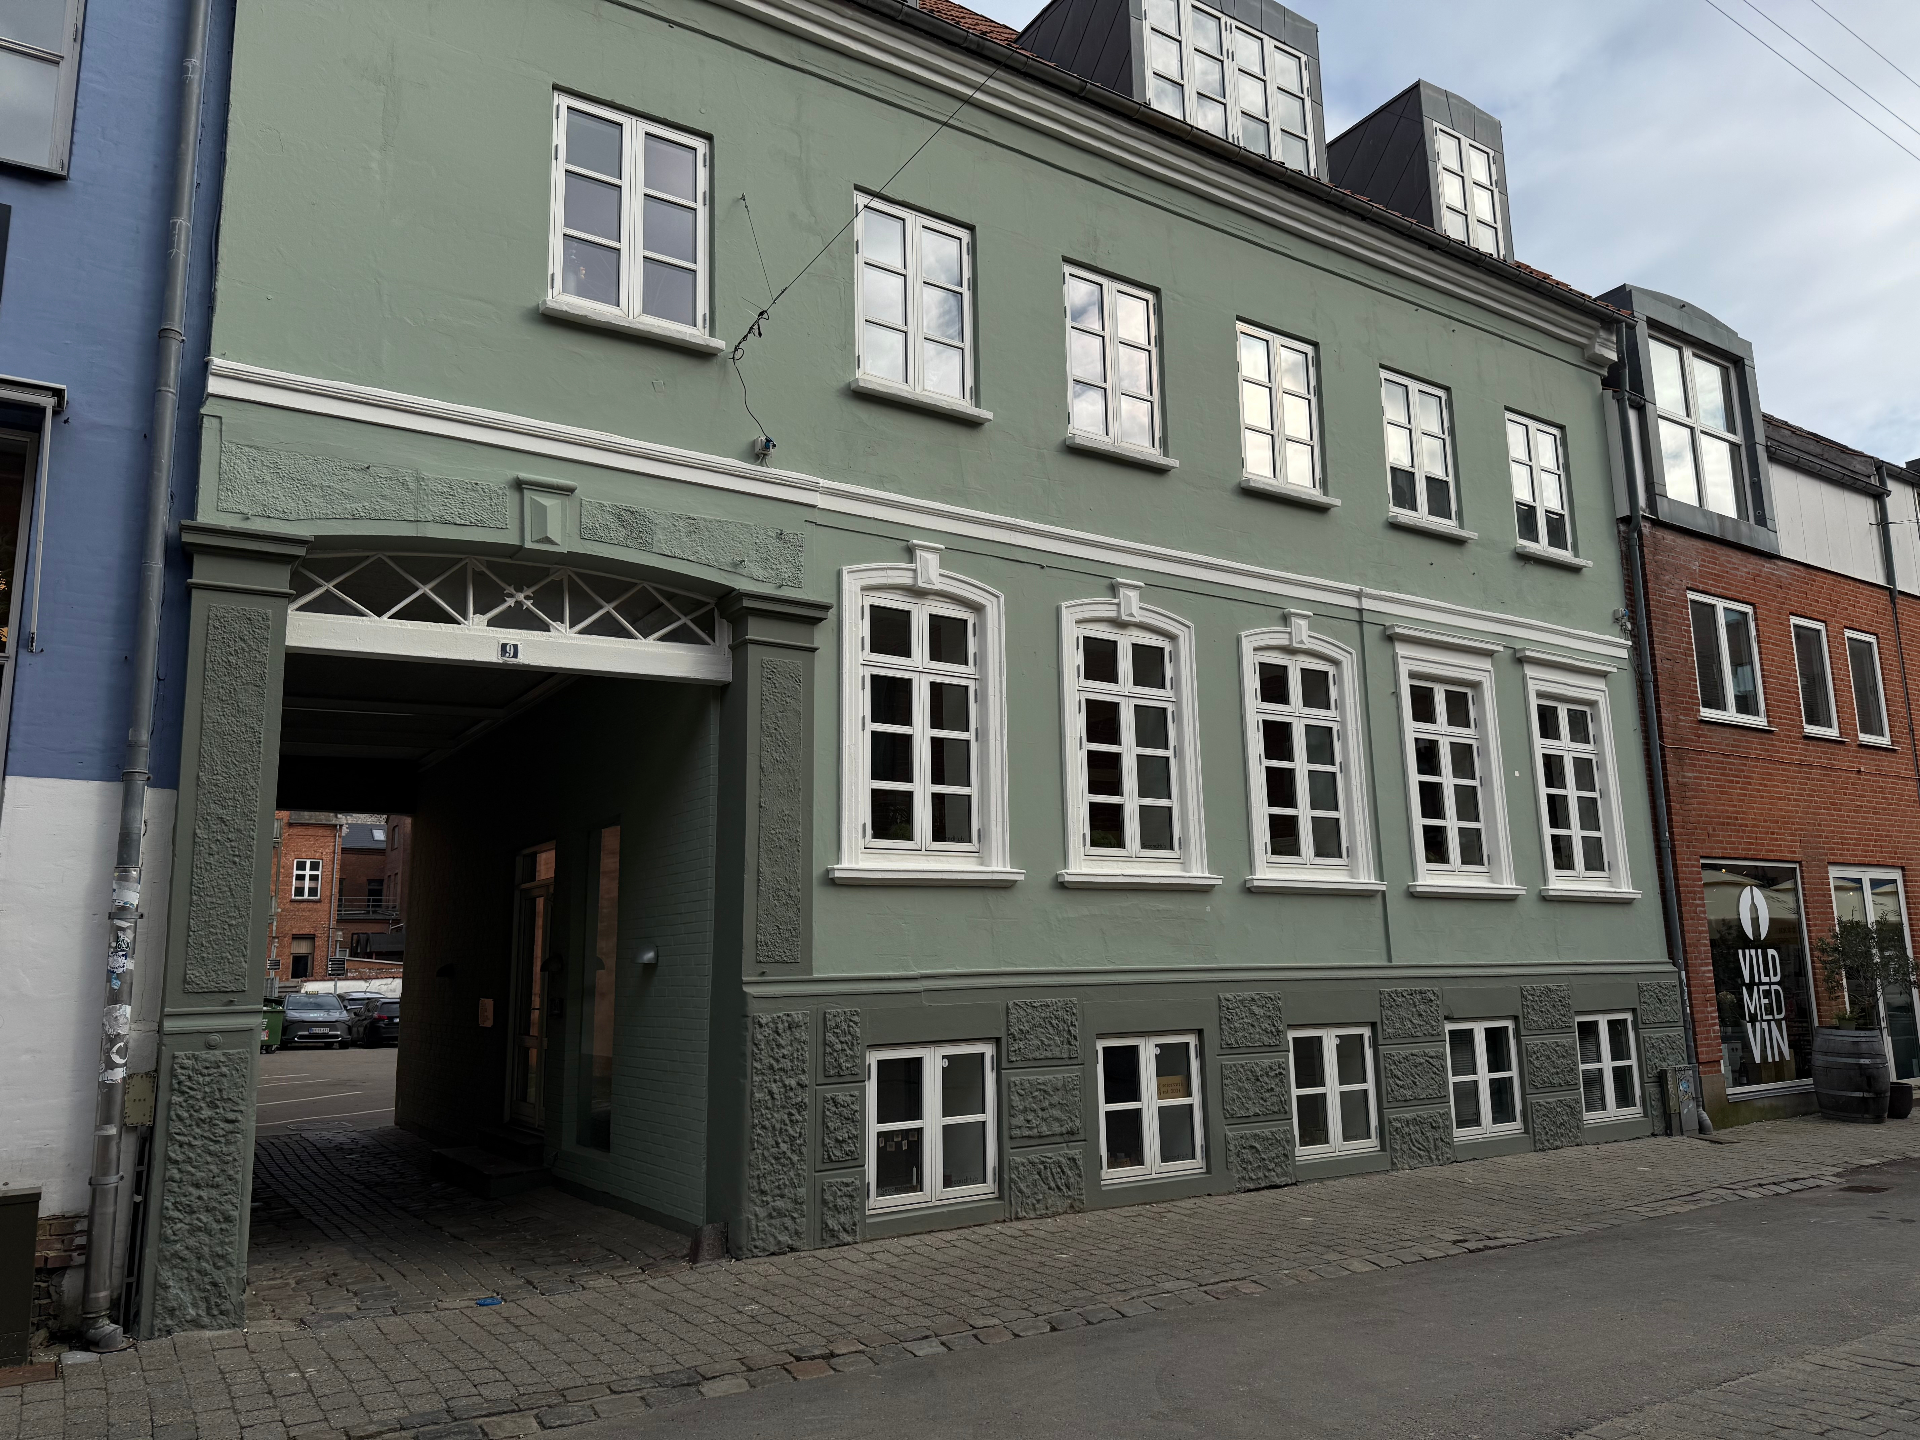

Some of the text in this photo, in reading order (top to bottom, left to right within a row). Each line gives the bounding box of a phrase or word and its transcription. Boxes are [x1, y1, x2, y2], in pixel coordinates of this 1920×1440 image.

[505, 643, 514, 658] 9
[1738, 948, 1781, 984] VILD
[1742, 984, 1786, 1021] MED
[1746, 1020, 1790, 1064] VIN
